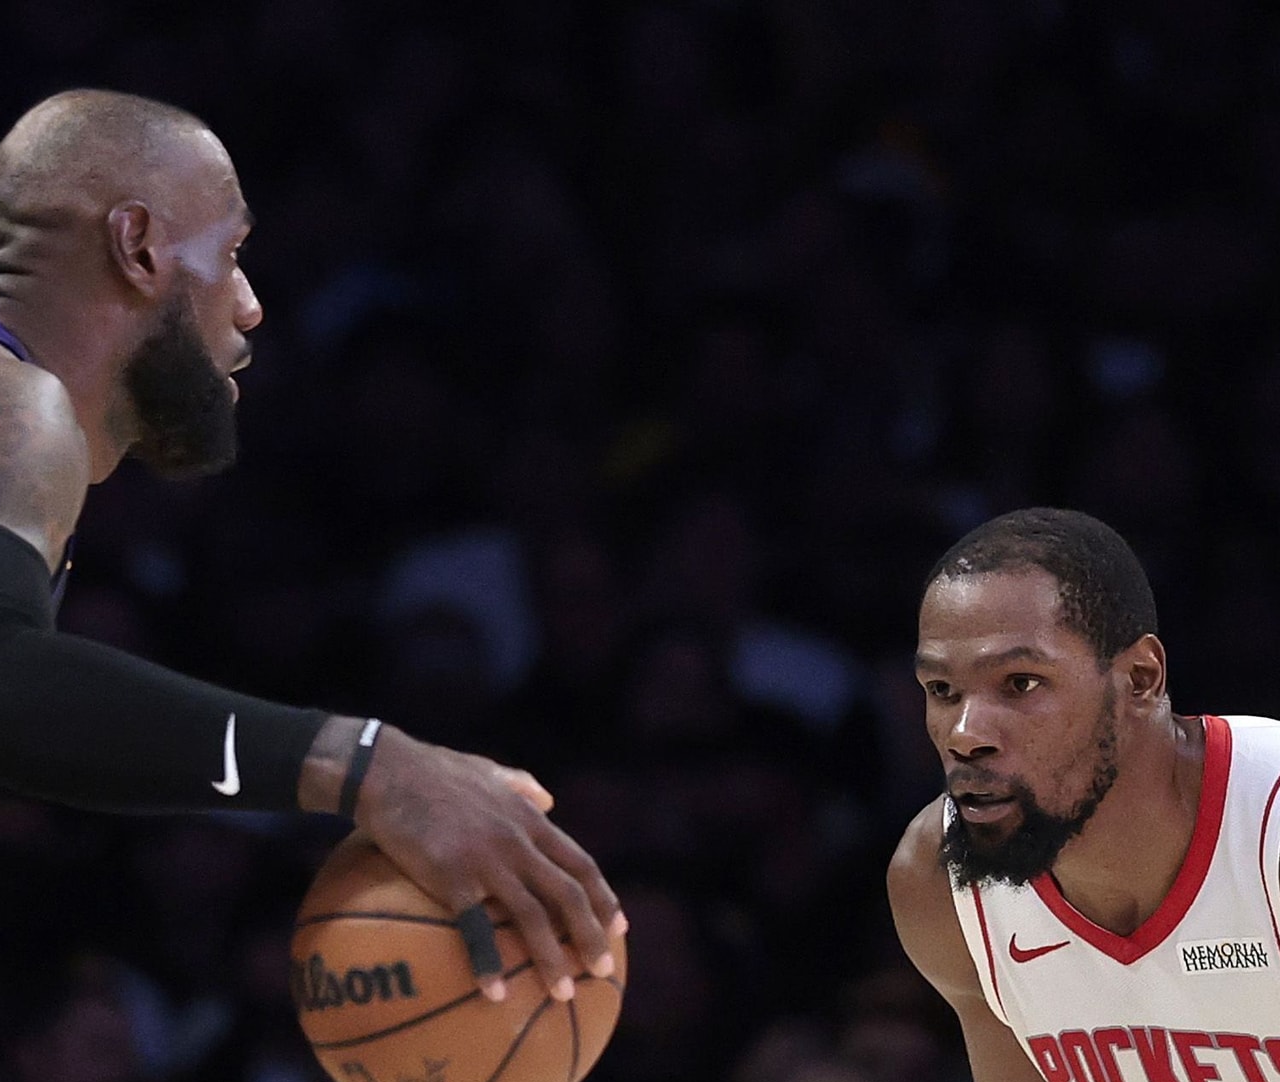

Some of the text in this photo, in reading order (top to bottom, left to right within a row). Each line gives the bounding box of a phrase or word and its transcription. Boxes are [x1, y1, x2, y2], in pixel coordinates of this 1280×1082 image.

[1182, 942, 1267, 960] MEMORIAL
[1184, 953, 1269, 972] HERMANN
[291, 953, 416, 1012] lson
